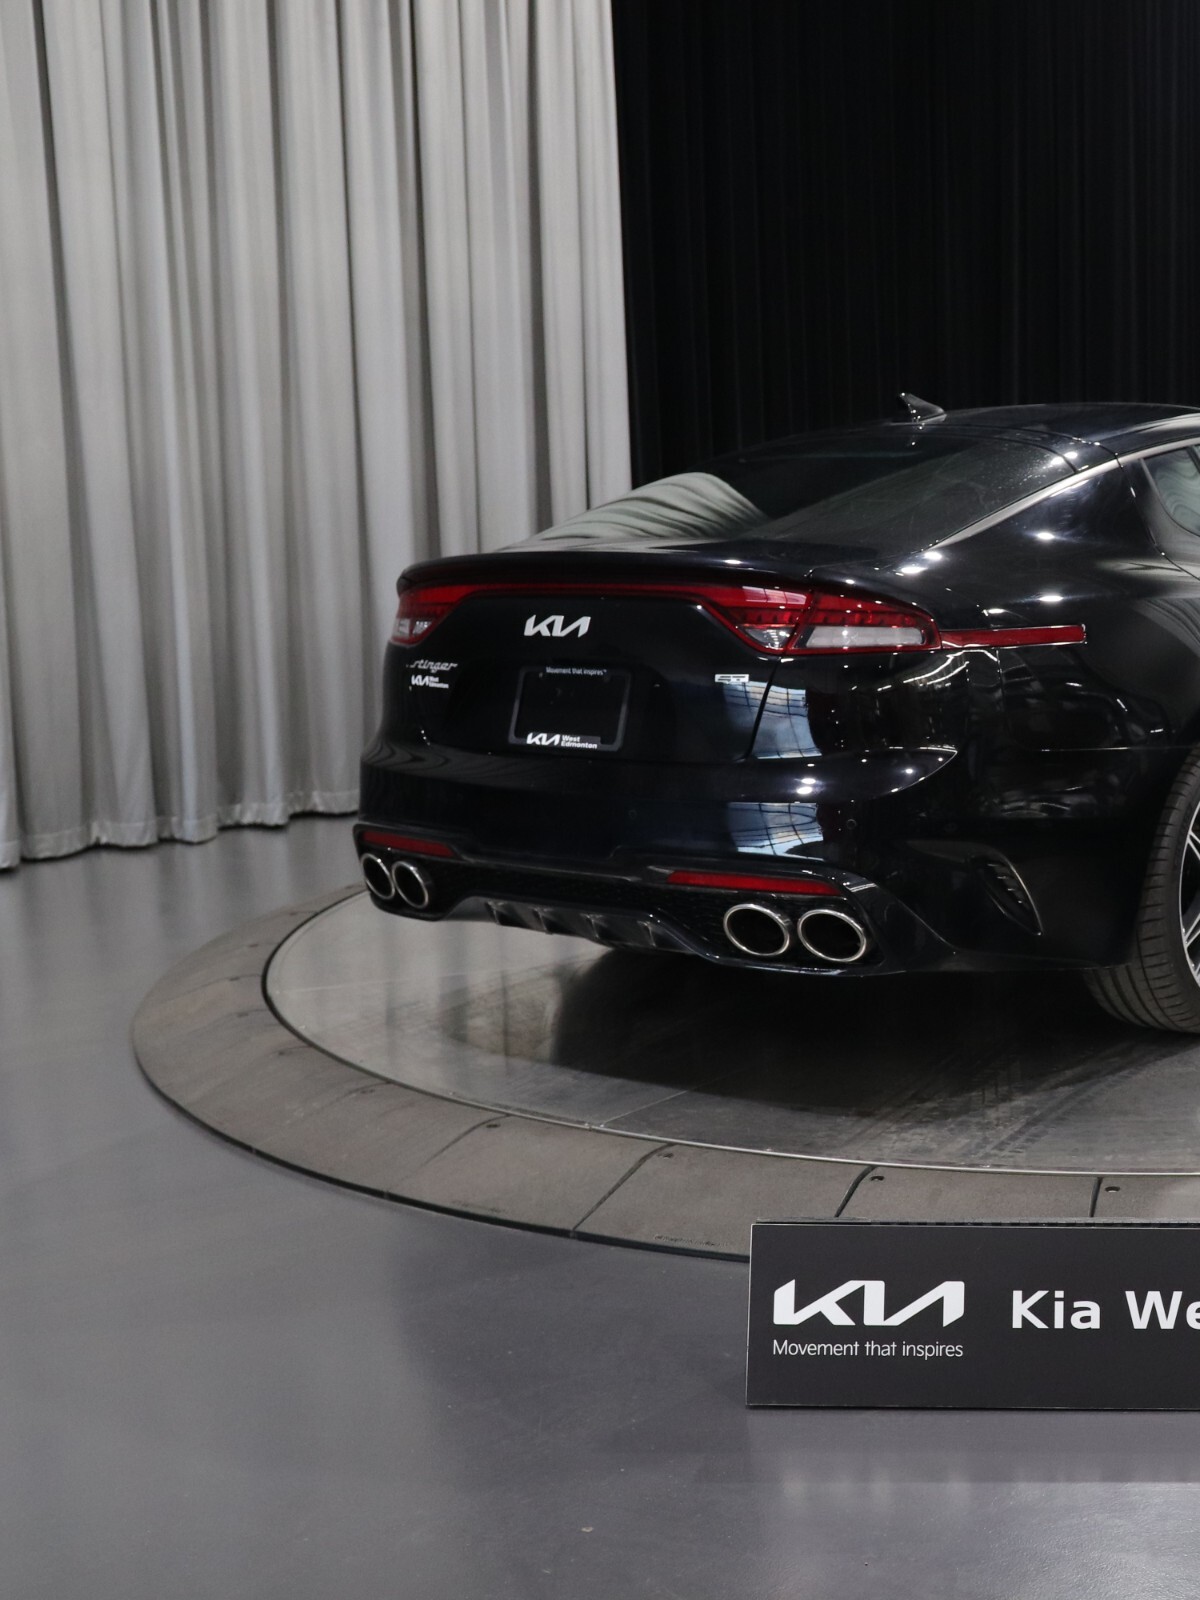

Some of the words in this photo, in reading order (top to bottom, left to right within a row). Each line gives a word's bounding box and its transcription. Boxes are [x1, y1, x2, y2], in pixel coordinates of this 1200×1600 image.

[524, 614, 591, 638] KIA
[561, 741, 598, 750] Edmonton
[562, 734, 581, 742] West
[773, 1279, 965, 1327] KIA
[1012, 1290, 1101, 1329] Kia
[772, 1339, 859, 1356] Movement
[865, 1341, 897, 1356] that
[902, 1341, 964, 1360] inspires
